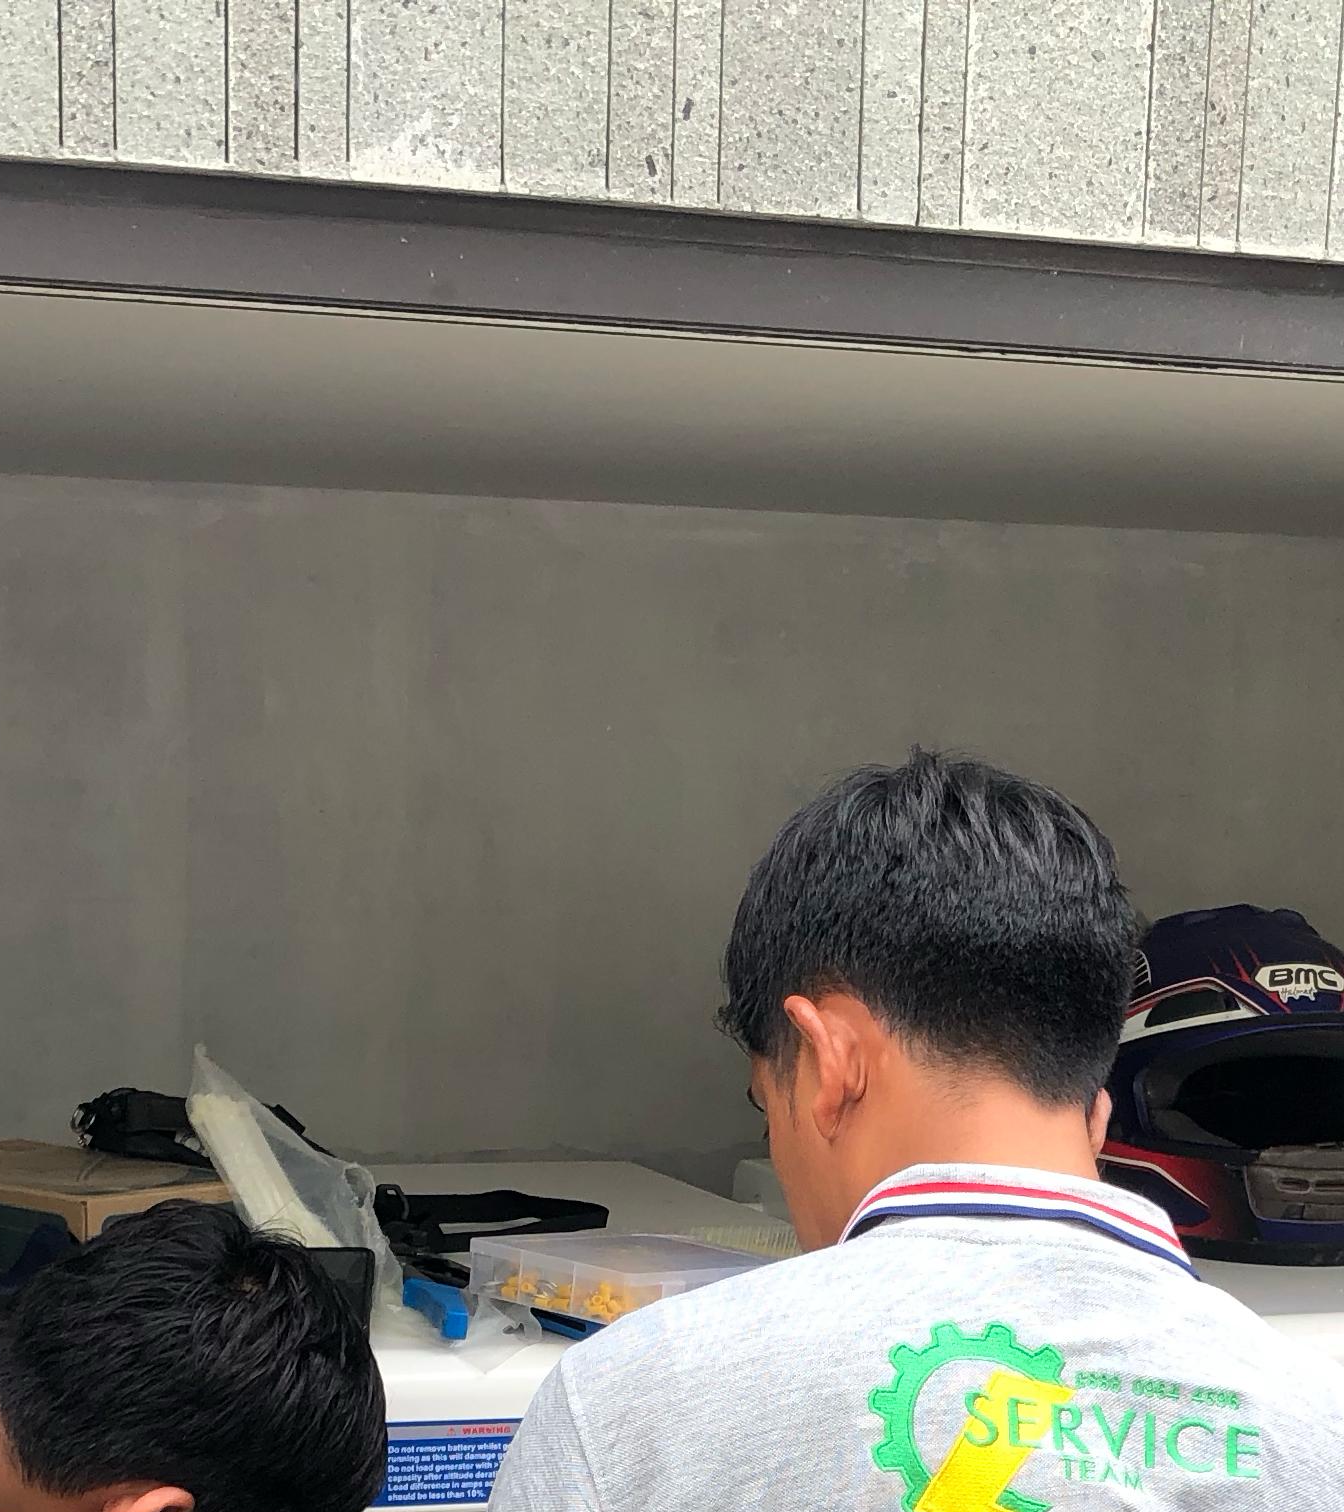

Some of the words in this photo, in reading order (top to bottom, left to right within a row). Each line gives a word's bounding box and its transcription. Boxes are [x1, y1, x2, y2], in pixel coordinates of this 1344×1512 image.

[1268, 967, 1338, 989] BMC
[462, 1425, 512, 1435] WARNING
[964, 1390, 1261, 1479] SERVICE
[401, 1445, 415, 1453] not
[448, 1443, 476, 1453] battery
[477, 1441, 502, 1450] whilst
[388, 1454, 420, 1463] running
[432, 1453, 448, 1461] this
[449, 1452, 463, 1460] will
[465, 1452, 496, 1461] damage
[388, 1464, 400, 1473] Do
[401, 1464, 415, 1472] not
[416, 1463, 434, 1472] load
[436, 1463, 474, 1472] generator
[475, 1461, 493, 1469] with
[1062, 1454, 1144, 1491] TEAM
[388, 1473, 422, 1483] capacity
[424, 1472, 442, 1481] after
[444, 1471, 474, 1480] altitude
[475, 1470, 497, 1479] derat
[388, 1483, 408, 1492] Load
[410, 1482, 450, 1490] difference
[452, 1481, 460, 1489] in
[461, 1481, 483, 1490] amps
[388, 1492, 416, 1501] should
[417, 1491, 427, 1500] be
[429, 1490, 446, 1499] less
[447, 1489, 465, 1498] than
